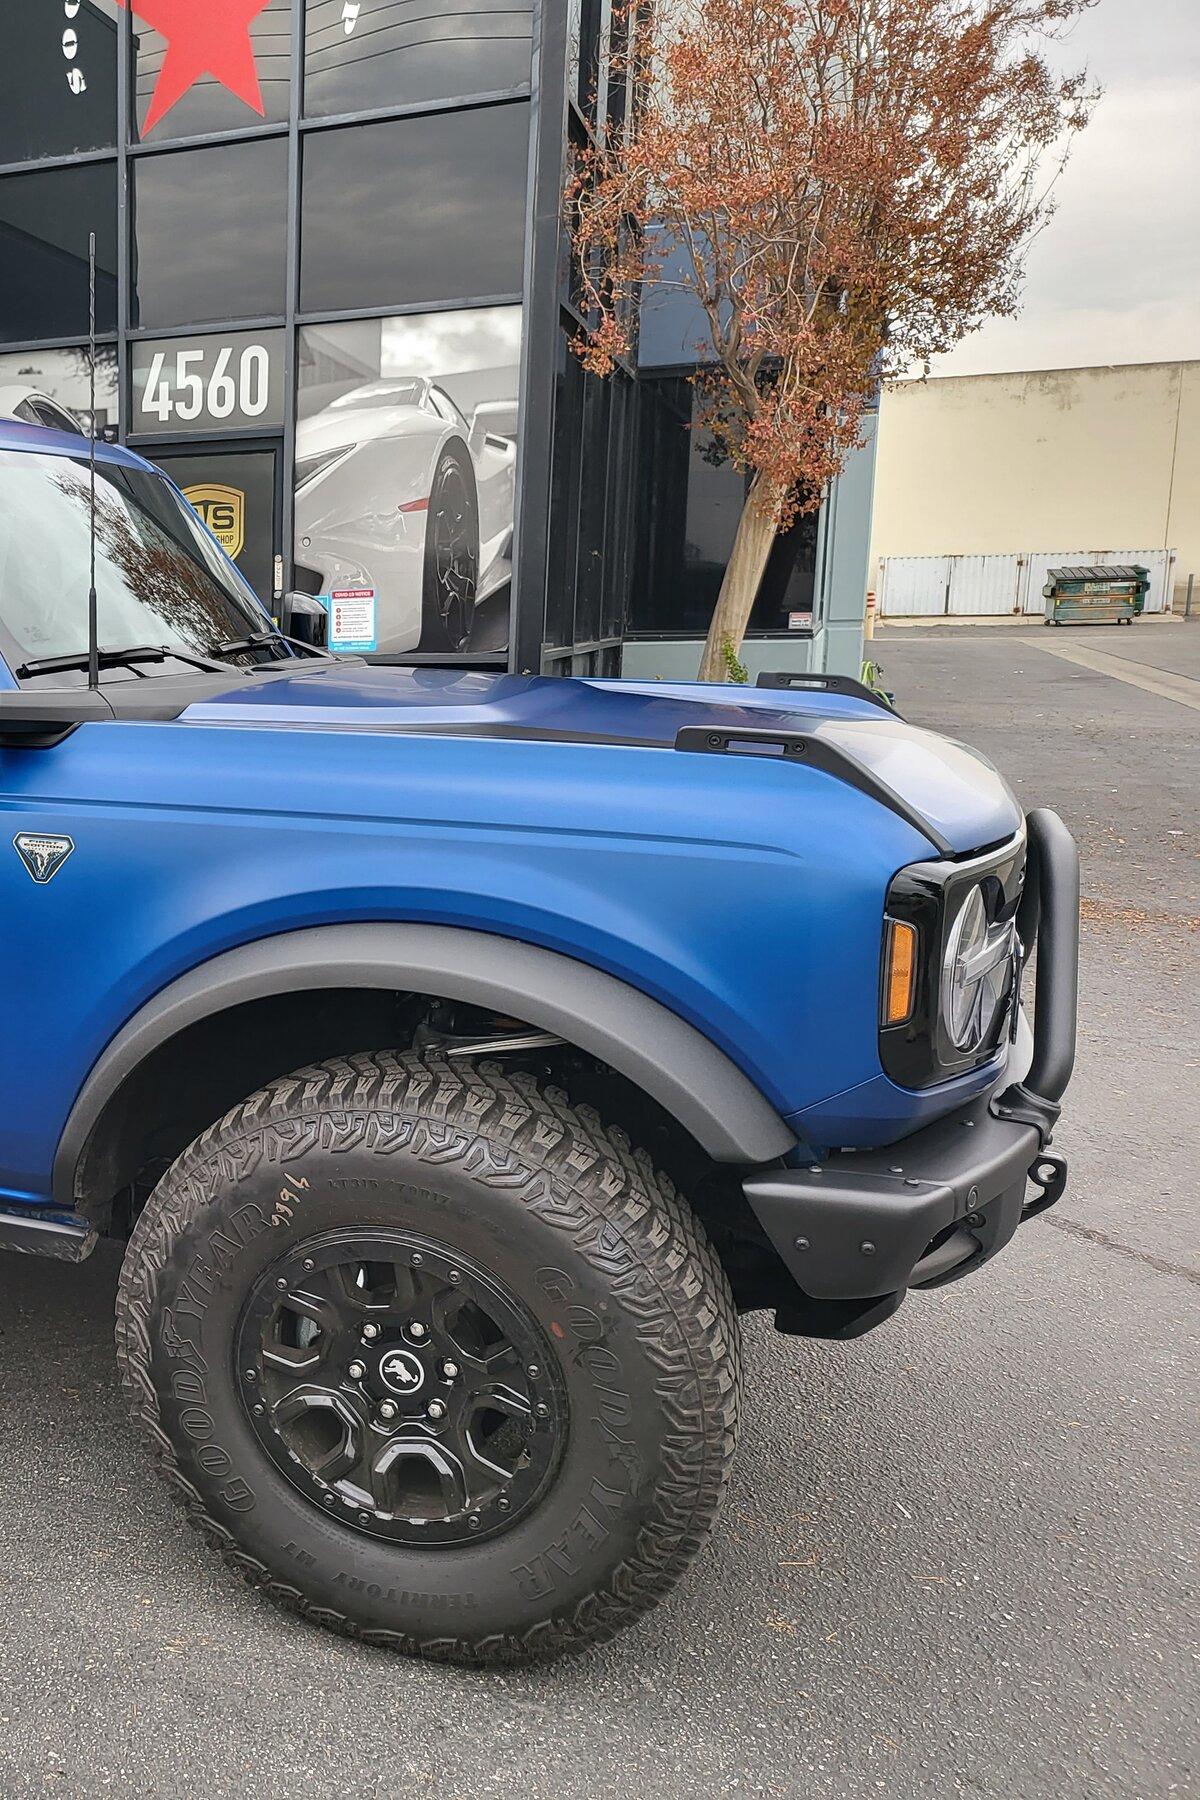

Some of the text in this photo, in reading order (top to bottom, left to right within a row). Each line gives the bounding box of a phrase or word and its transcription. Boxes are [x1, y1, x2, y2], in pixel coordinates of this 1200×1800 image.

[141, 345, 269, 421] 4560
[160, 1202, 272, 1512] GOODYEAR
[510, 1266, 644, 1601] GOODYEAR
